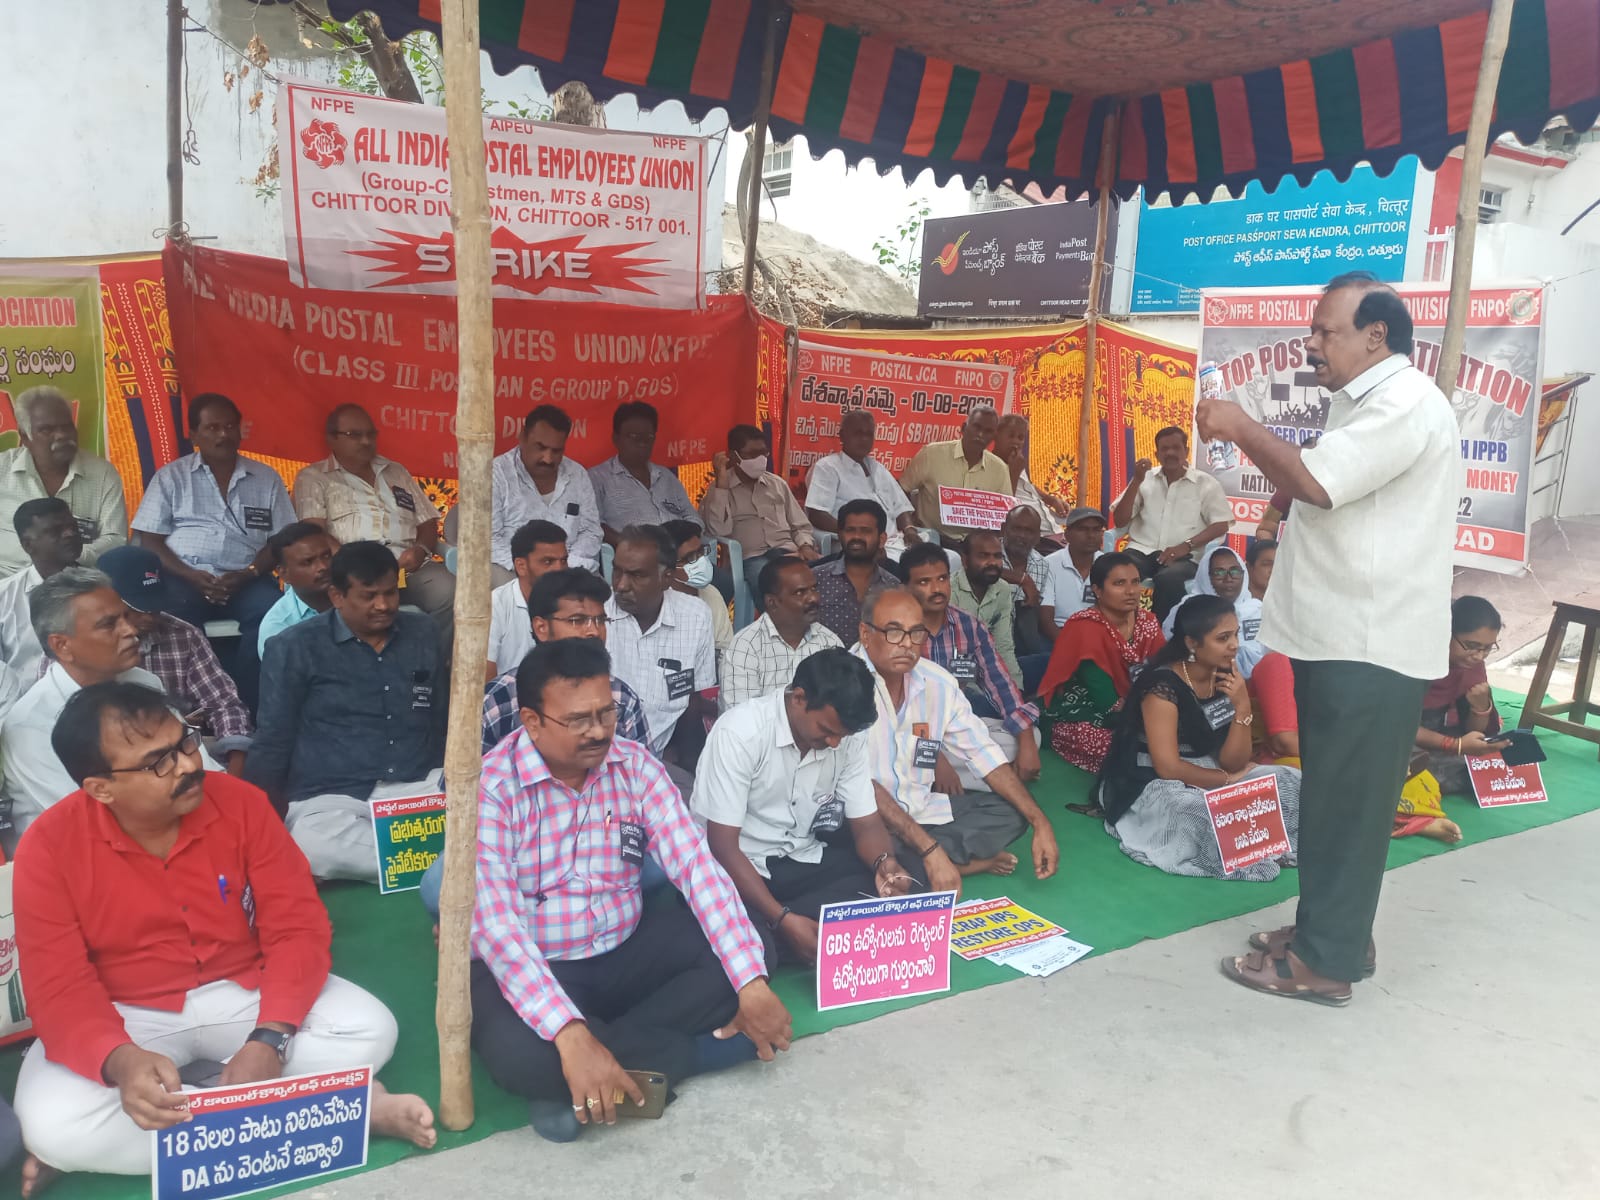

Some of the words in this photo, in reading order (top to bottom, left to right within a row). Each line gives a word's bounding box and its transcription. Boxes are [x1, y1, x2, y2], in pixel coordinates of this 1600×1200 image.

[311, 97, 355, 114] NFPE
[490, 119, 533, 135] AIPEU
[653, 136, 687, 150] NFPE
[354, 127, 390, 164] ALL
[483, 140, 532, 178] STAL
[538, 145, 636, 187] EMPLOYEES
[640, 157, 694, 191] UNION
[311, 191, 418, 216] CHITTOOR
[424, 199, 511, 223] DIVN,
[518, 207, 610, 230] CHITTOOR
[625, 216, 653, 232] 517
[658, 219, 691, 236] 001.
[488, 186, 544, 206] stmen,
[551, 188, 586, 206] MTS
[591, 192, 602, 208] &
[608, 193, 651, 215] GDS)
[1246, 213, 1263, 224] डाक
[1267, 212, 1280, 222] घर
[1284, 205, 1319, 221] पासपोर्ट
[1322, 203, 1341, 217] सेवा
[1184, 236, 1204, 247] POST
[1205, 234, 1234, 246] OFFICE
[1236, 230, 1282, 243] PASSPORT
[1284, 228, 1307, 240] SEVA
[1308, 226, 1351, 238] KENDRA,
[1353, 221, 1406, 236] CHITTOOR
[416, 243, 593, 280] SRIKE
[1080, 250, 1096, 261] Ban
[0, 297, 77, 327] CIATION
[1229, 303, 1254, 320] NFPE
[1260, 299, 1303, 322] POSTAL
[1471, 299, 1505, 318] FNPO
[304, 301, 402, 347] POSTAL
[424, 318, 556, 362] EMYEES
[14, 346, 76, 379] సంఘం
[293, 345, 386, 383] (CLASS
[529, 377, 548, 401] &
[821, 354, 852, 374] NFPE
[870, 361, 913, 381] POSTAL
[915, 364, 937, 383] JCA
[954, 369, 984, 388] FNPO
[1216, 351, 1256, 393] TOP
[1259, 336, 1311, 378] POS
[911, 390, 995, 416] 10-08-20
[380, 404, 457, 436] CHITT
[666, 440, 707, 458] NFPE
[1472, 439, 1508, 463] IPPB
[1466, 468, 1519, 494] MONEY
[952, 507, 965, 515] SAVE
[966, 508, 975, 516] THE
[986, 911, 1018, 924] NPS
[826, 932, 851, 956] GDS
[853, 923, 906, 960] ఉద్యోగులను
[910, 915, 946, 952] రెగ్యులర్
[951, 926, 1018, 948] RESTORE
[1013, 919, 1044, 933] OPS
[832, 960, 888, 998] ఉద్యోగులుగా
[890, 954, 936, 990] గుర్తించాలి
[163, 1130, 190, 1158] 18
[192, 1125, 236, 1153] నెలల
[238, 1115, 282, 1145] పాటు
[285, 1095, 363, 1134] నిలిపివేసిన
[182, 1166, 211, 1192] DA
[213, 1162, 234, 1186] ను
[237, 1140, 293, 1180] వెంటనే
[294, 1135, 344, 1169] ఇవ్వాలి
